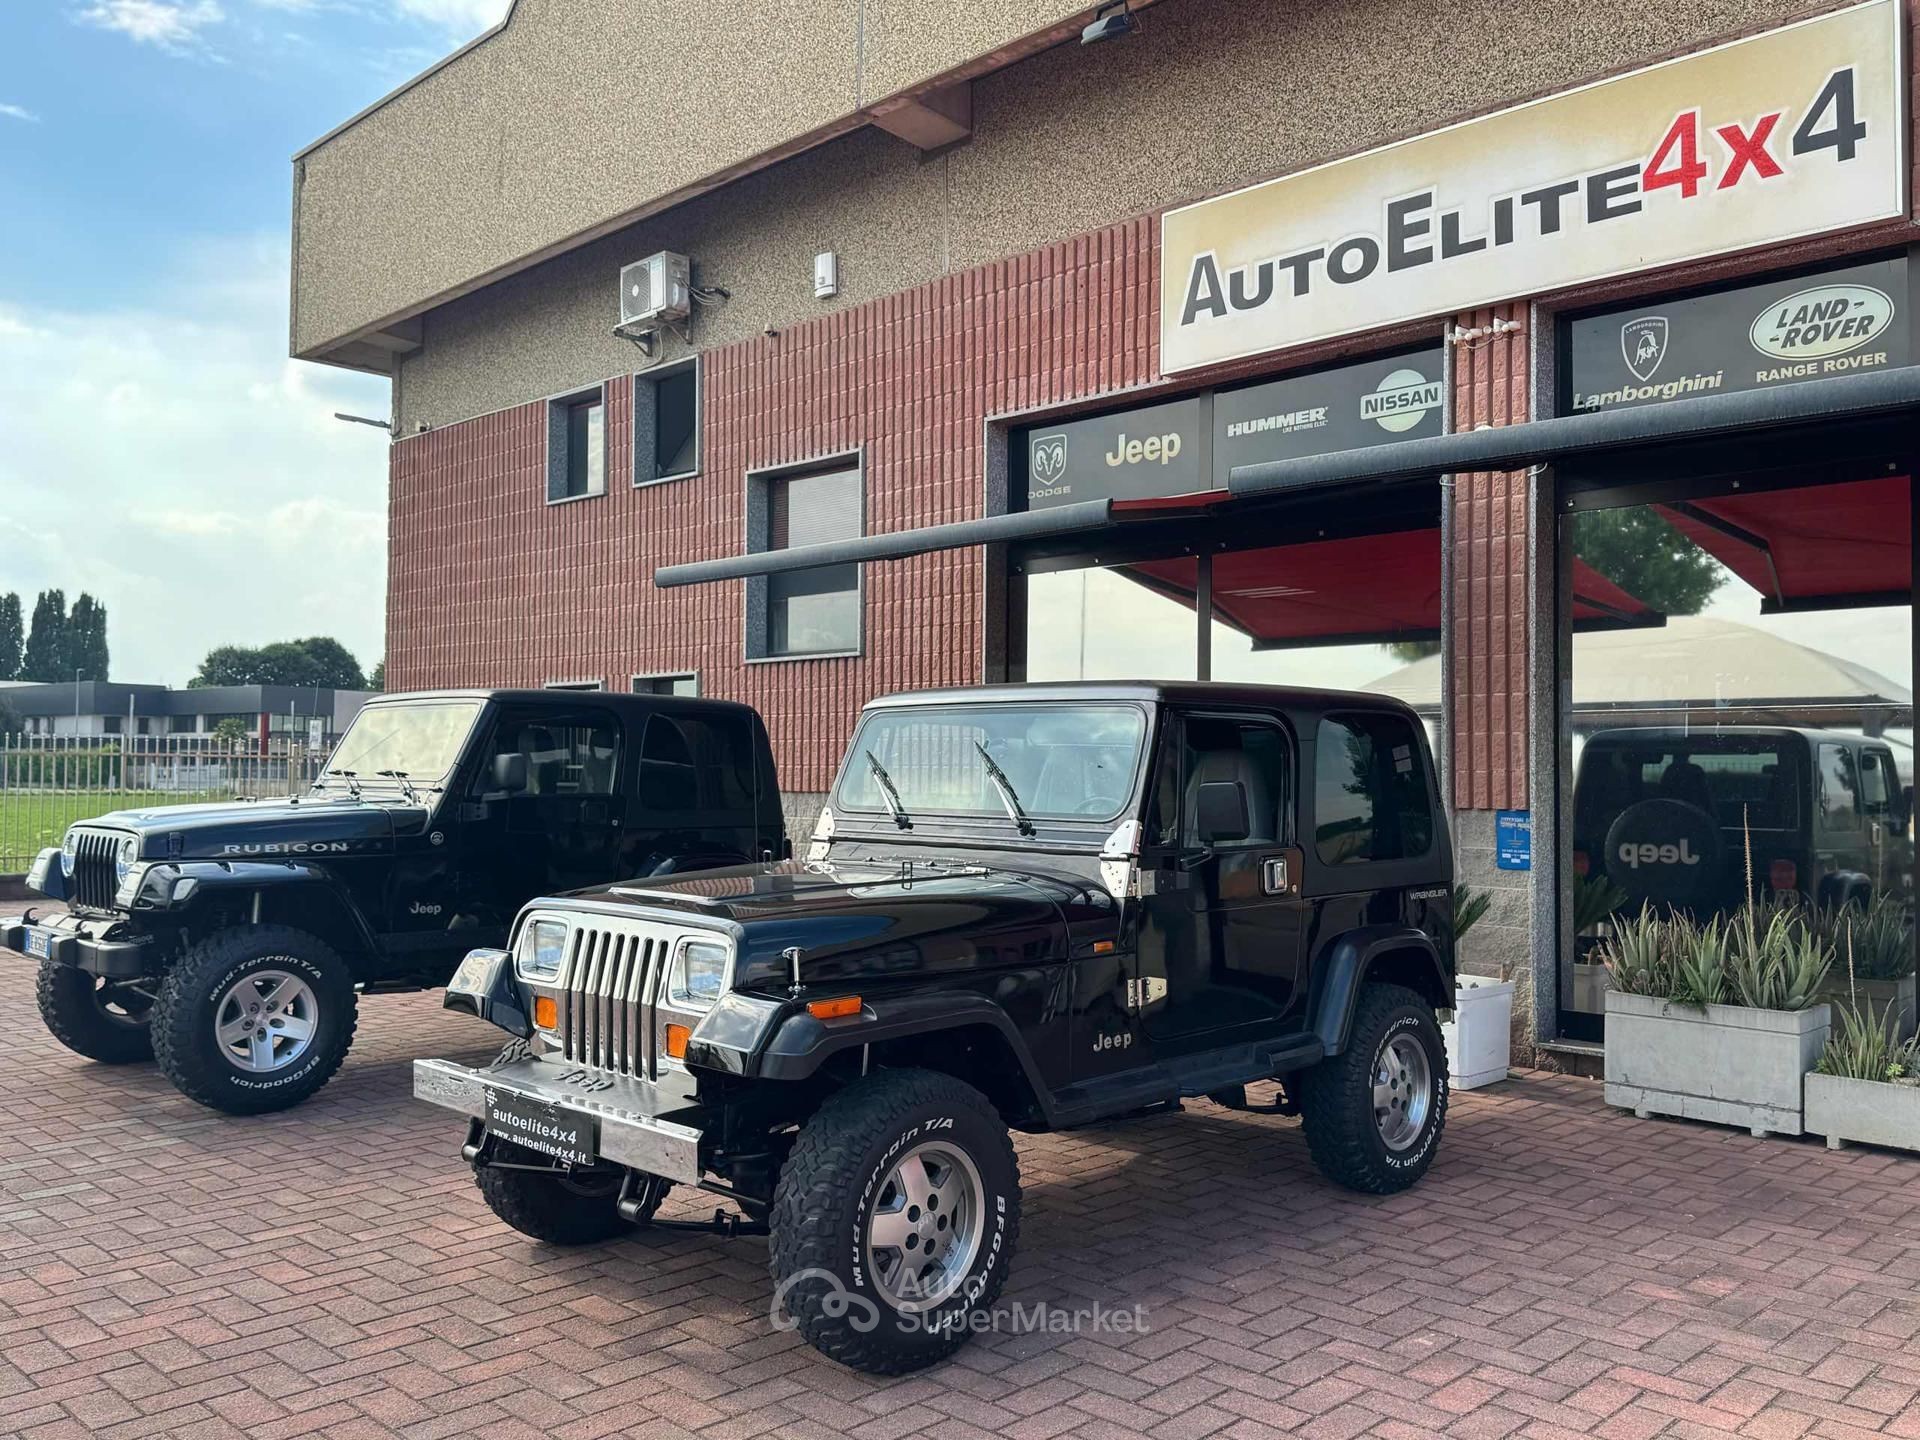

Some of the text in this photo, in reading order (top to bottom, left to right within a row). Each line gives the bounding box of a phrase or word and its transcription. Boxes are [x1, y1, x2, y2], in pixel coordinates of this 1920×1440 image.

[1756, 352, 1887, 383] RANGE ROVER
[1364, 386, 1439, 415] NISSAN
[1572, 370, 1723, 410] Lamborghini
[1227, 407, 1327, 438] HUMMER
[1105, 432, 1181, 467] Jeep
[1028, 485, 1072, 500] DODGE
[224, 842, 348, 854] RUBICON
[409, 902, 442, 915] Jeep
[1410, 888, 1448, 900] WRANGLER
[209, 954, 323, 1002] Mud-Terrain T/A
[1093, 1033, 1132, 1051] Jeep
[229, 1055, 321, 1090] BFGoodrich
[552, 1069, 615, 1093] Jeep
[492, 1108, 578, 1145] autoelite4x4
[852, 1116, 954, 1288] Mud-Terrain T/A
